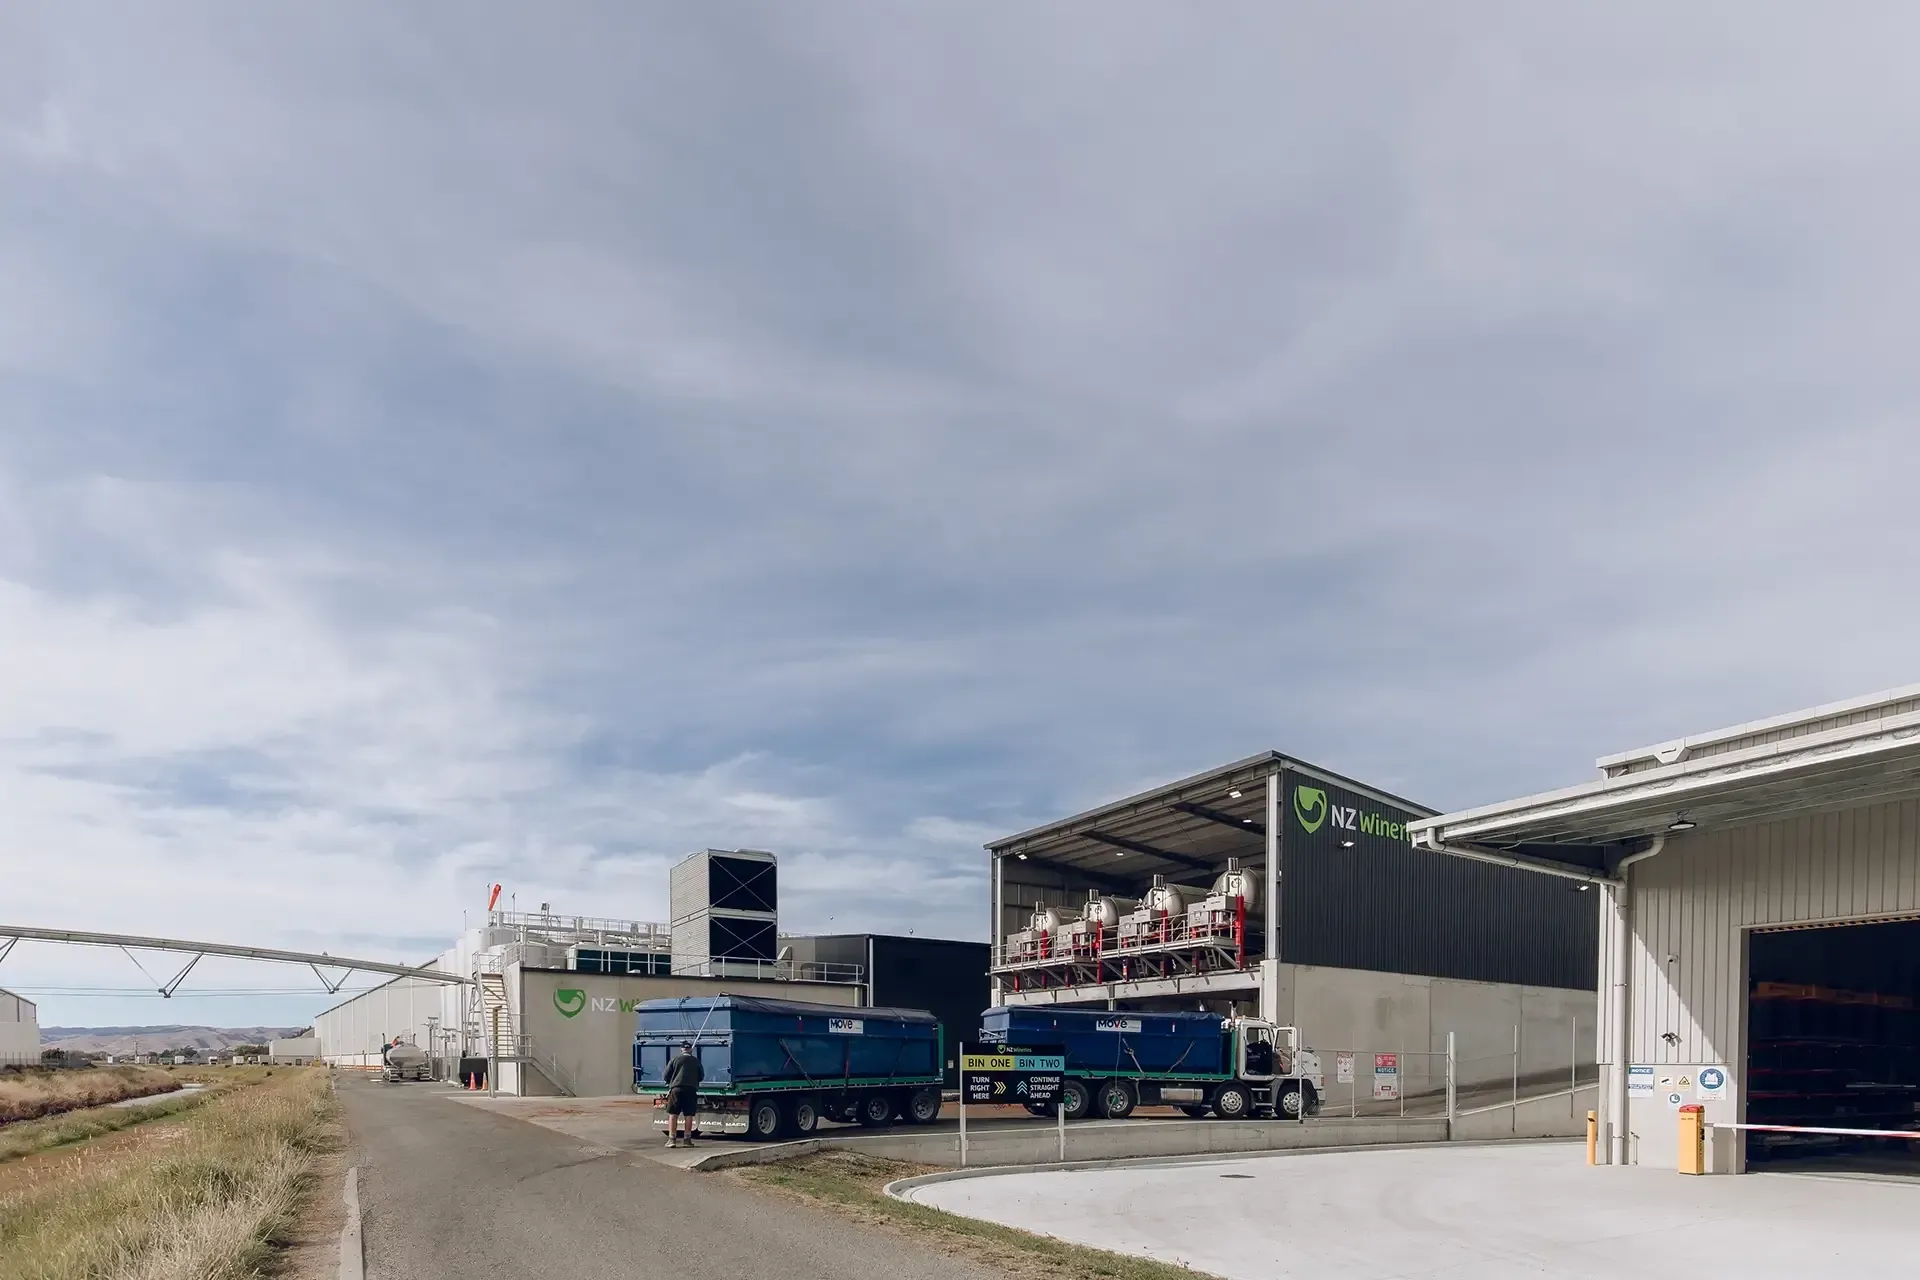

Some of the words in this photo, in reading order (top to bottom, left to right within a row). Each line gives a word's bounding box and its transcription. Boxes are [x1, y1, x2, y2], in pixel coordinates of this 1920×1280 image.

[1331, 804, 1357, 831] NZ
[591, 997, 616, 1012] NZ
[968, 1058, 985, 1068] BIN
[990, 1058, 1011, 1068] ONE
[1019, 1059, 1035, 1068] BIN
[1040, 1059, 1061, 1068] TWO
